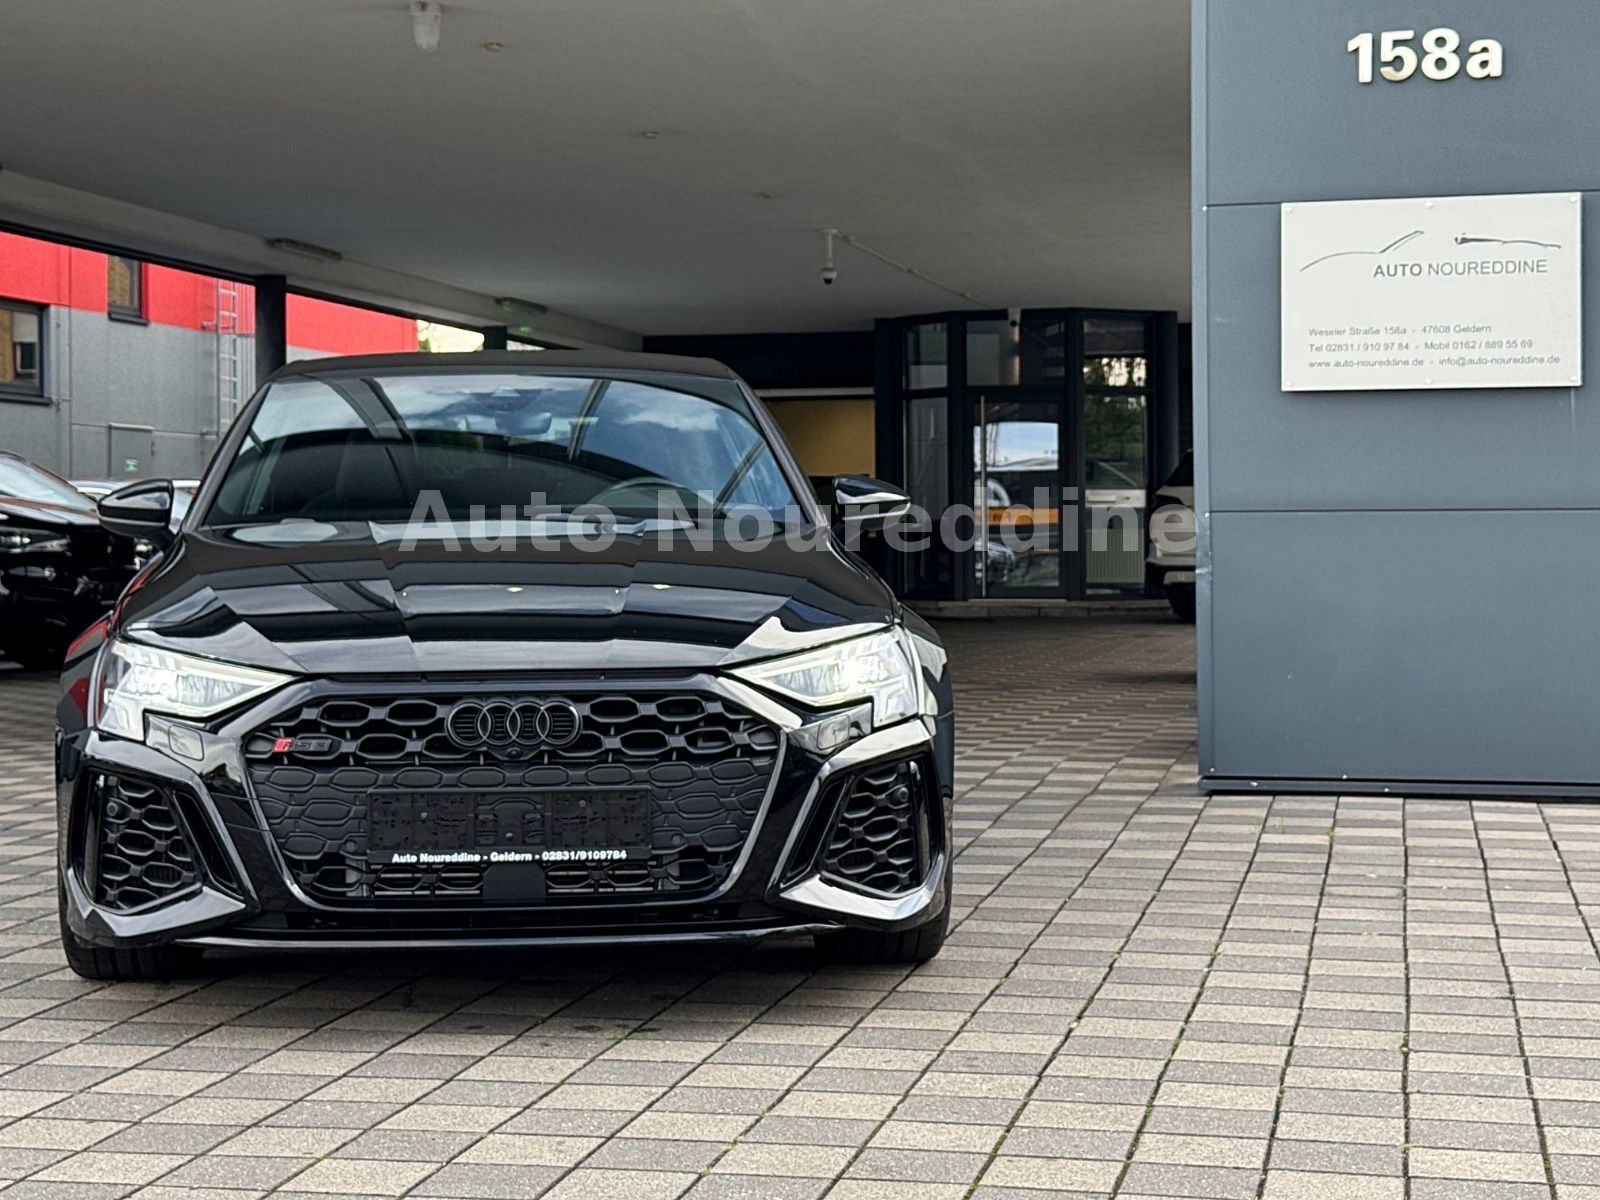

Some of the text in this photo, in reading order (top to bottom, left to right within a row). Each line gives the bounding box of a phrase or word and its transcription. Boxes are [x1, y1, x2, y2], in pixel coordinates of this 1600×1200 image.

[1347, 27, 1503, 83] 158a
[1373, 259, 1548, 278] AUTO NOUREDDINE
[1349, 326, 1381, 336] Straße
[1421, 324, 1451, 334] 47608
[1453, 324, 1492, 333] Geldern
[1309, 343, 1323, 352] Tel
[1383, 341, 1395, 351] 97
[1424, 341, 1450, 350] Mobil
[1308, 358, 1424, 368] www.auto-noureddine.de
[1439, 355, 1560, 366] info@auto-noureddine.de
[392, 853, 418, 864] Auto
[419, 852, 481, 863] Noureddine
[490, 851, 533, 862] Geldern
[541, 850, 628, 861] 02831/9109784
